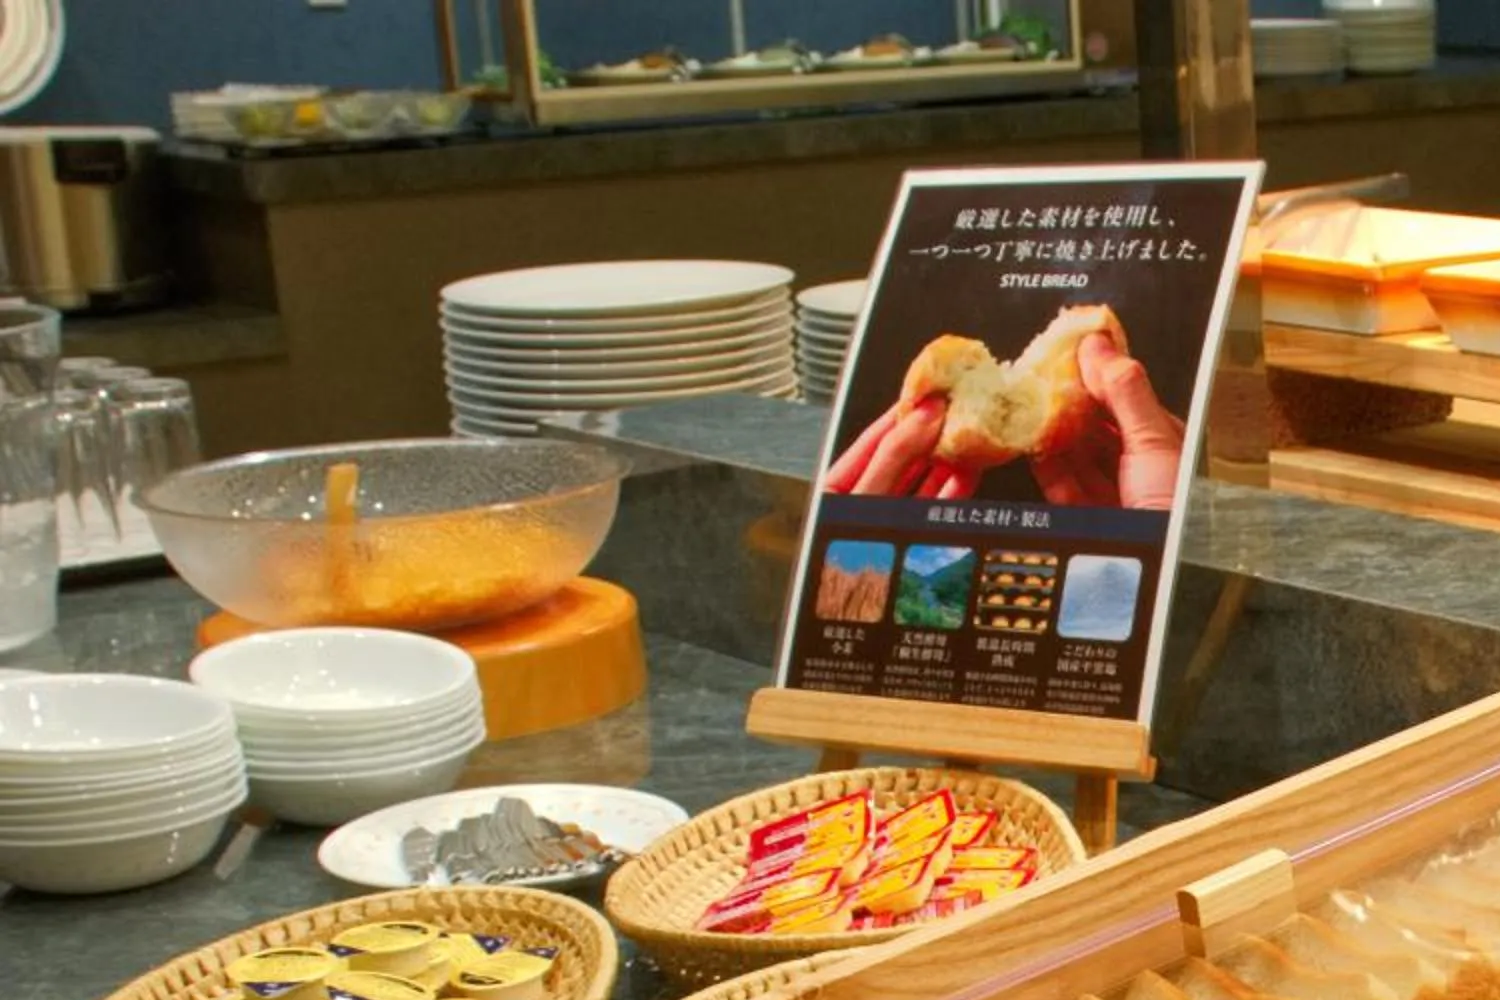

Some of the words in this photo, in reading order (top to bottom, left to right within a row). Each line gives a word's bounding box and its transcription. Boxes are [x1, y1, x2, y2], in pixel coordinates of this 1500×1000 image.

[954, 205, 1176, 230] 厳選した素材を使用し、
[908, 239, 1208, 262] 一つ一つ丁寧に焼き上げました。
[1000, 273, 1041, 288] STYLE
[1041, 273, 1090, 288] BREAD
